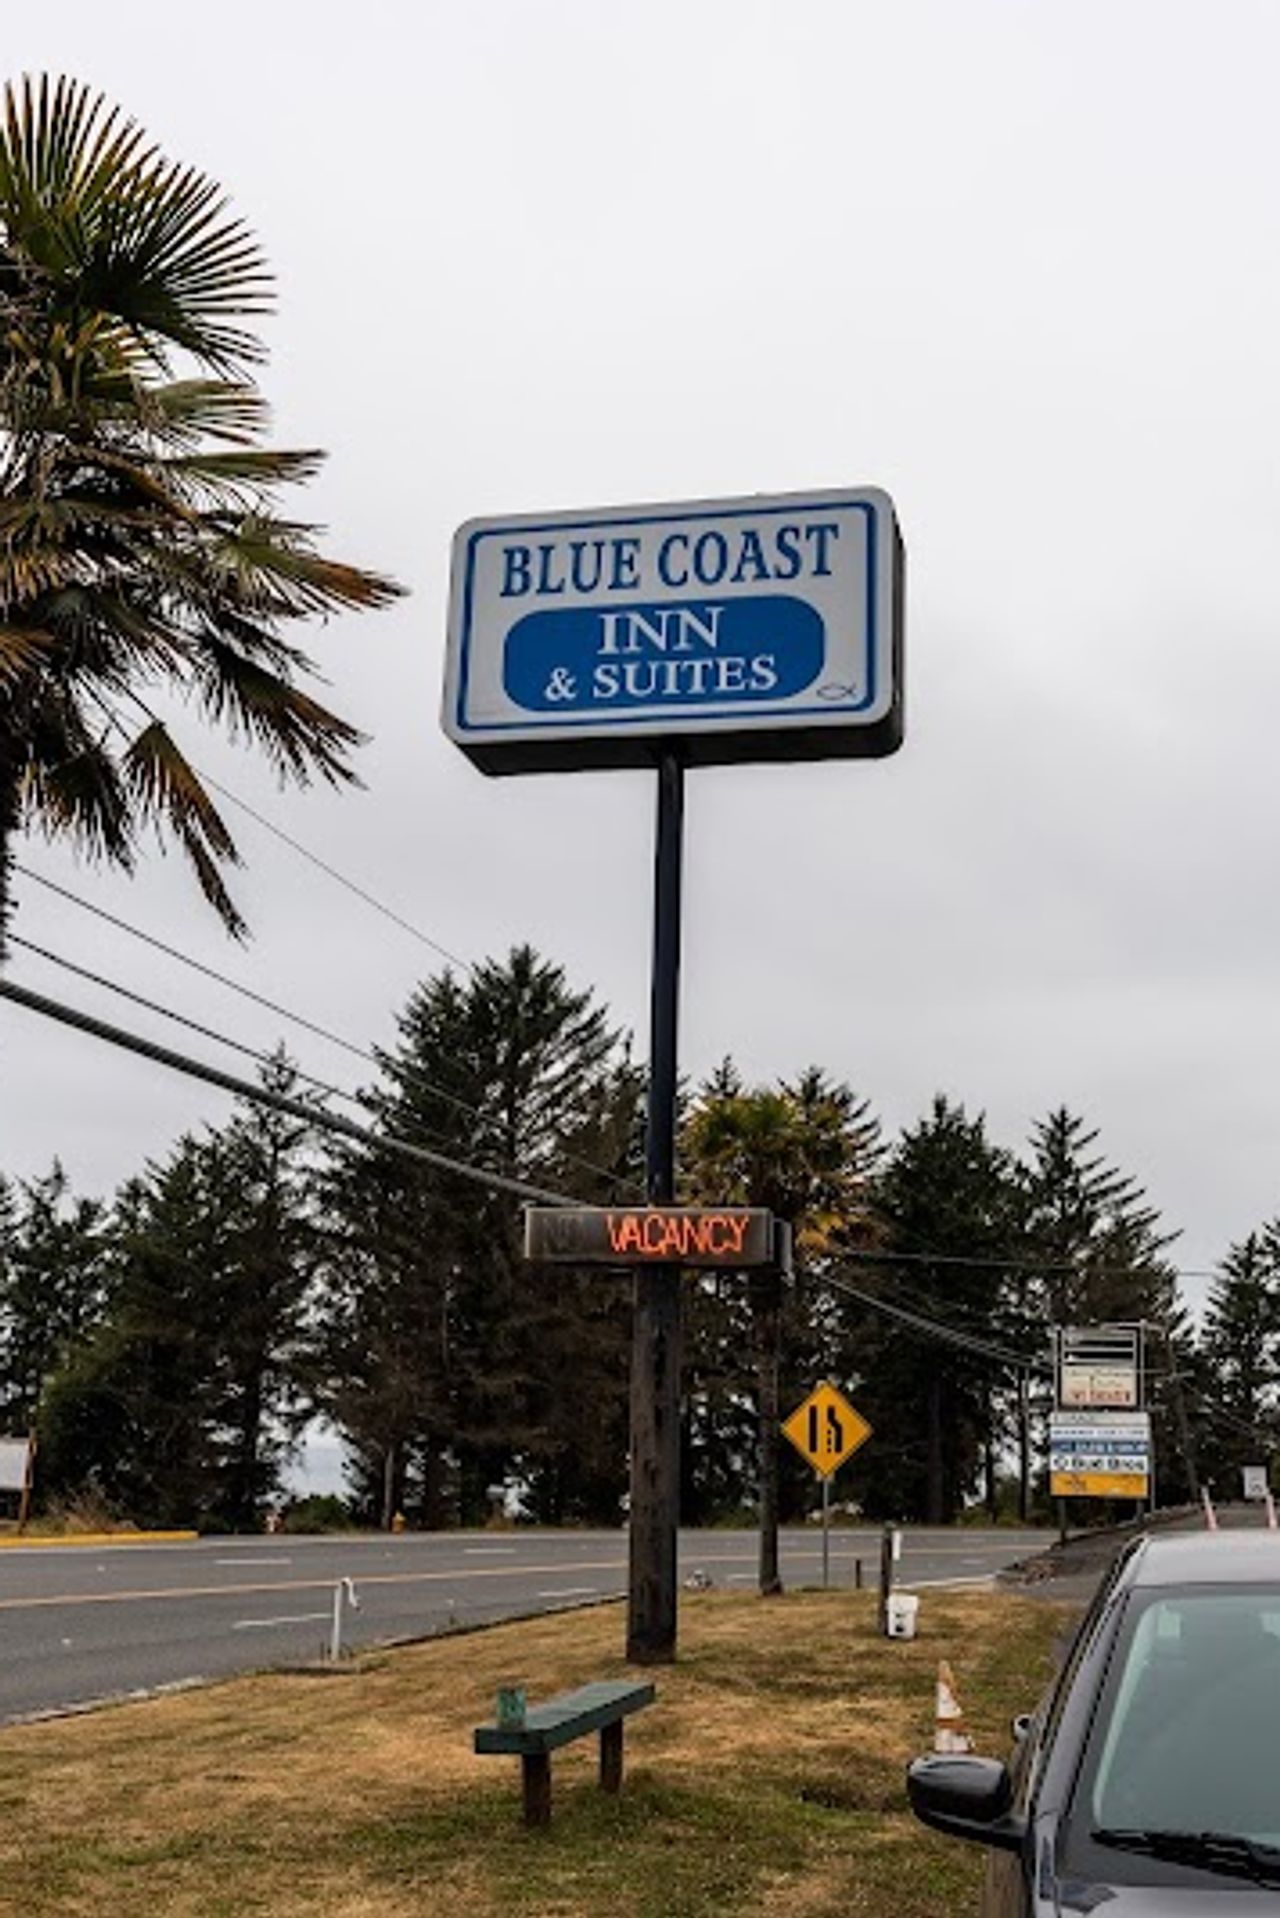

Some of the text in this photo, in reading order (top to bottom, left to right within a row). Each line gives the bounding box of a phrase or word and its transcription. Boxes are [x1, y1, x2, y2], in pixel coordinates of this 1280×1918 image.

[499, 524, 840, 597] BLUE COAST
[597, 606, 724, 655] INN
[544, 653, 779, 701] & SUITES
[606, 1213, 749, 1255] VACANCY
